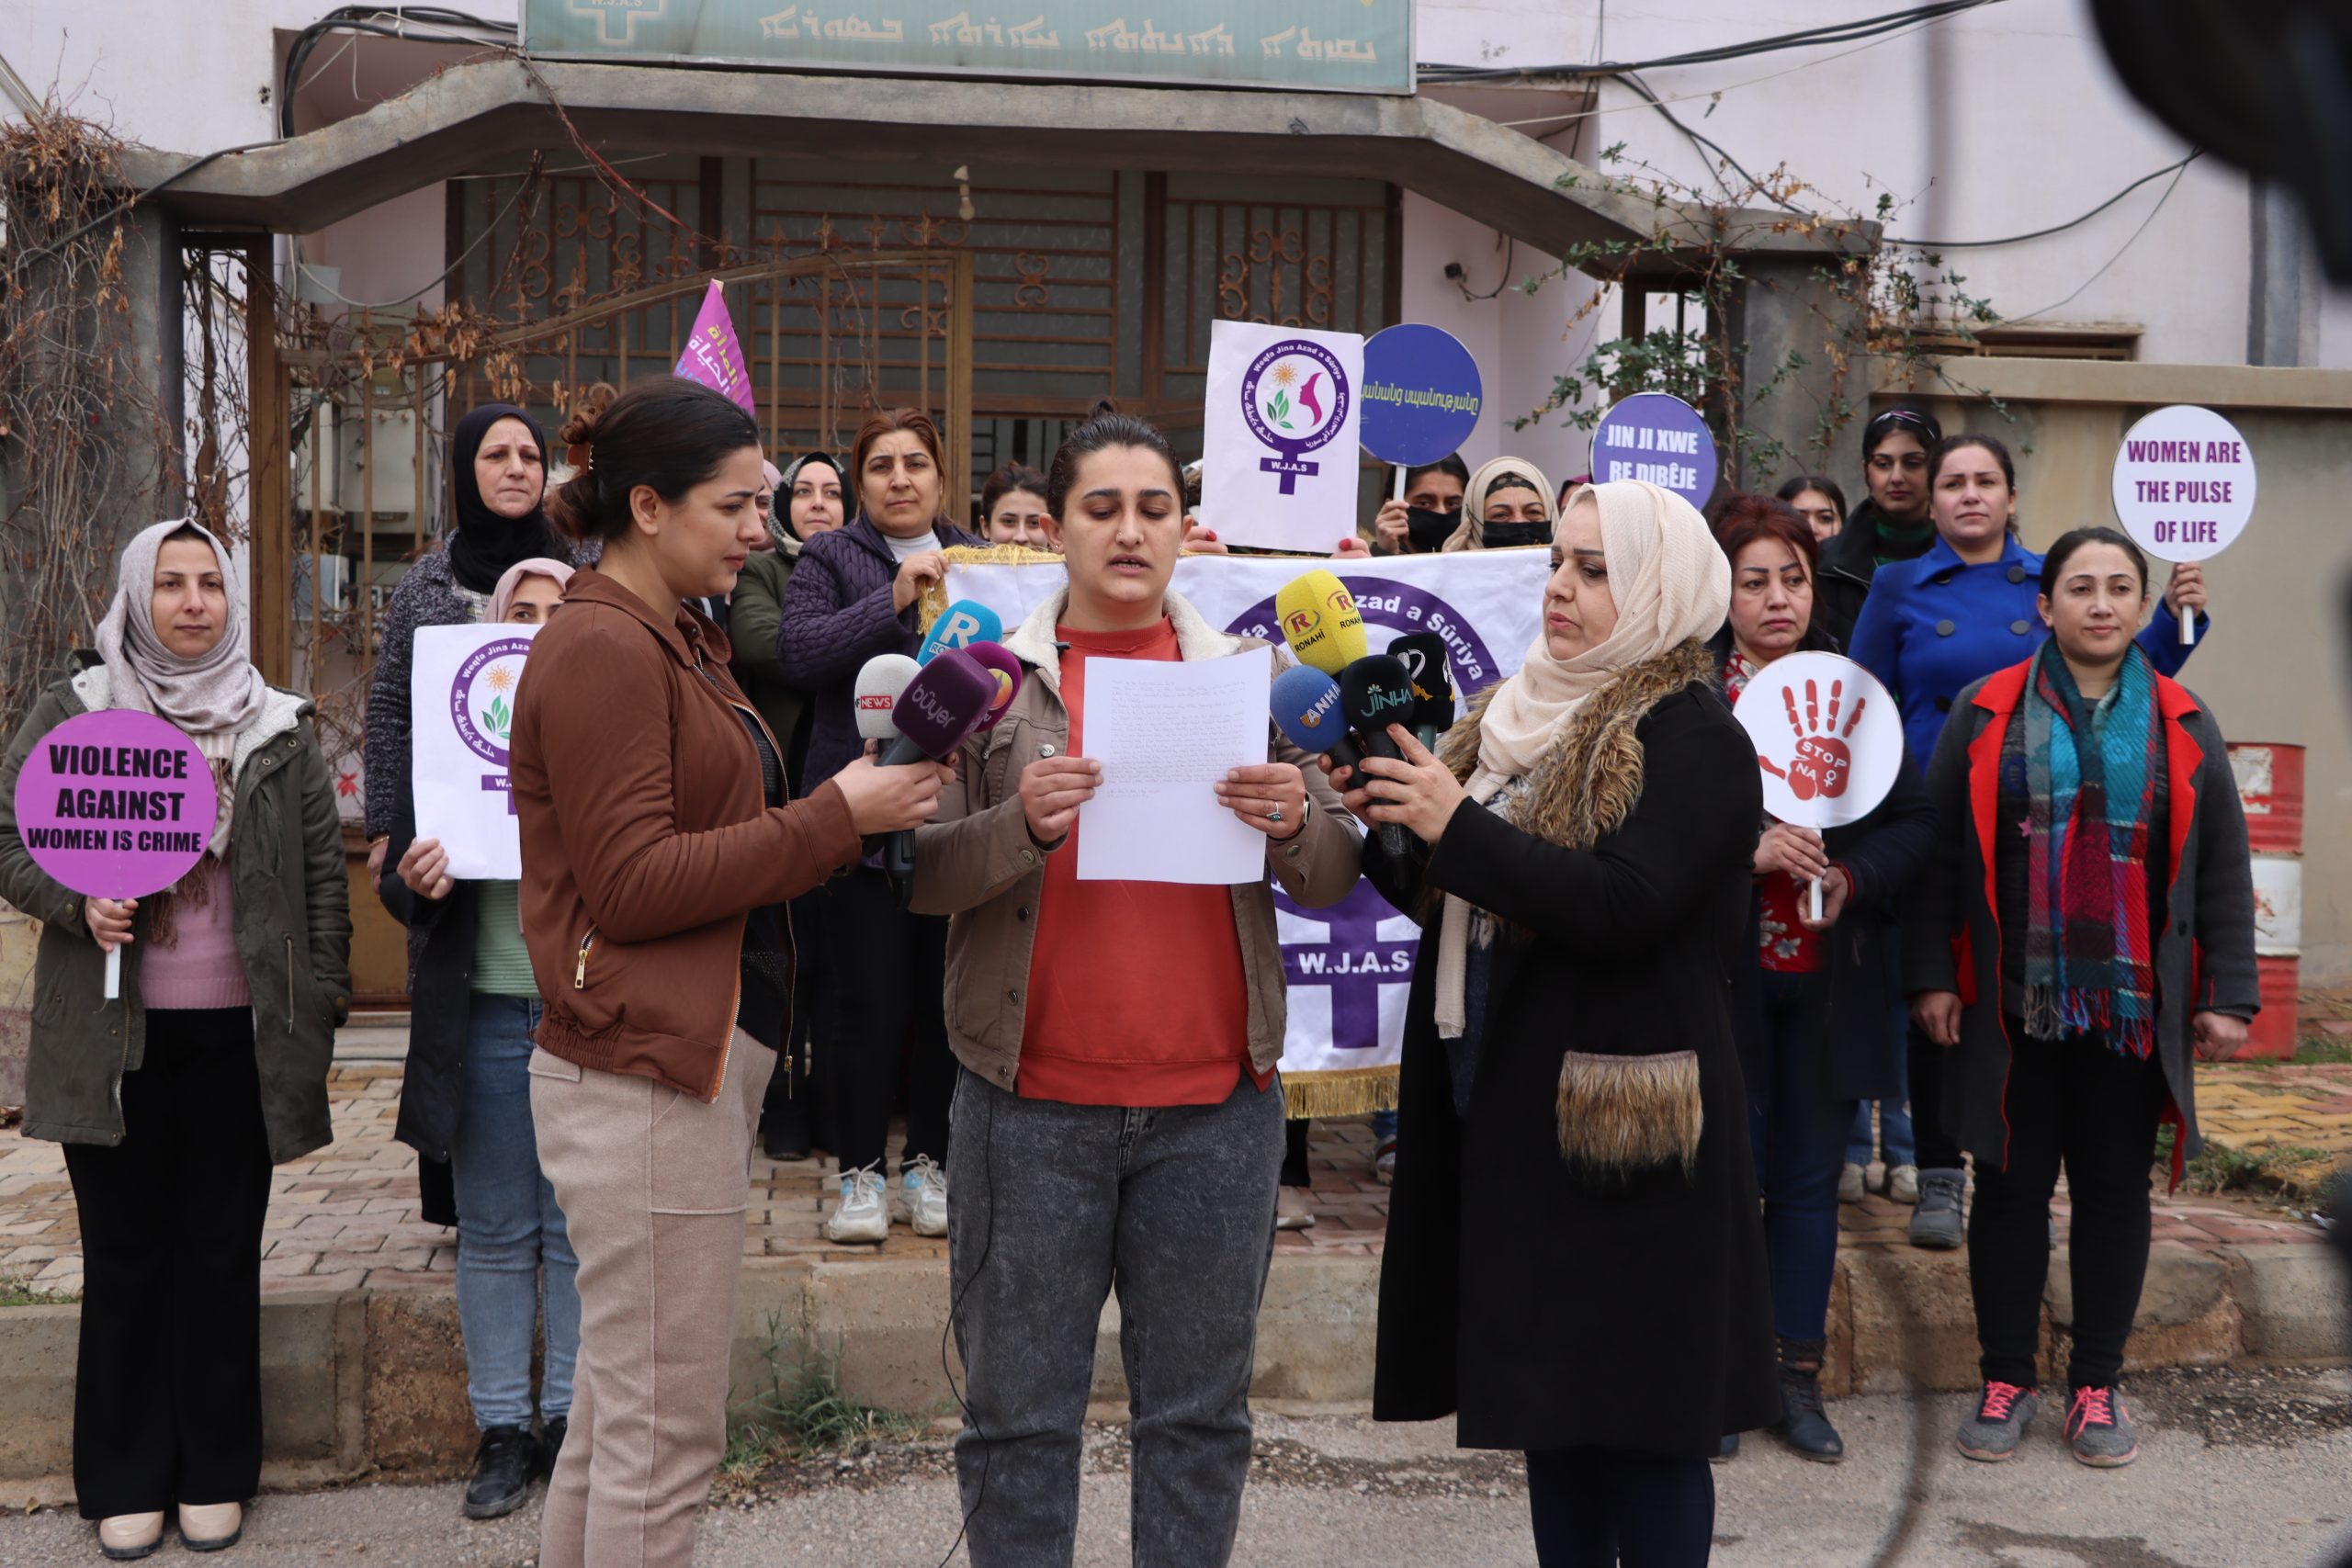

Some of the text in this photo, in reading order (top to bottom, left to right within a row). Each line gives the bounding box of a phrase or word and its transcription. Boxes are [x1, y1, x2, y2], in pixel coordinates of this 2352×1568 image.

[1277, 345, 1295, 354] Jina
[1296, 344, 1317, 355] Azad
[1606, 424, 1698, 454] JIN JI XWE
[2128, 441, 2241, 463] WOMEN ARE
[1272, 461, 1307, 472] W.J.A.S
[2135, 481, 2232, 502] THE PULSE
[2154, 521, 2217, 542] OF LIFE
[1291, 614, 1311, 633] R
[1354, 593, 1483, 681] zad a Sûriya
[487, 644, 508, 656] Jina
[511, 642, 529, 650] Aza
[862, 698, 891, 707] NEWS
[1306, 683, 1340, 723] ANHA
[49, 744, 187, 779] VIOLENCE
[1802, 741, 1847, 768] STOP
[1795, 762, 1816, 780] NA
[55, 788, 185, 821] AGAINST
[28, 829, 201, 852] WOMEN IS CRIME
[1298, 951, 1410, 975] W.J.A.S
